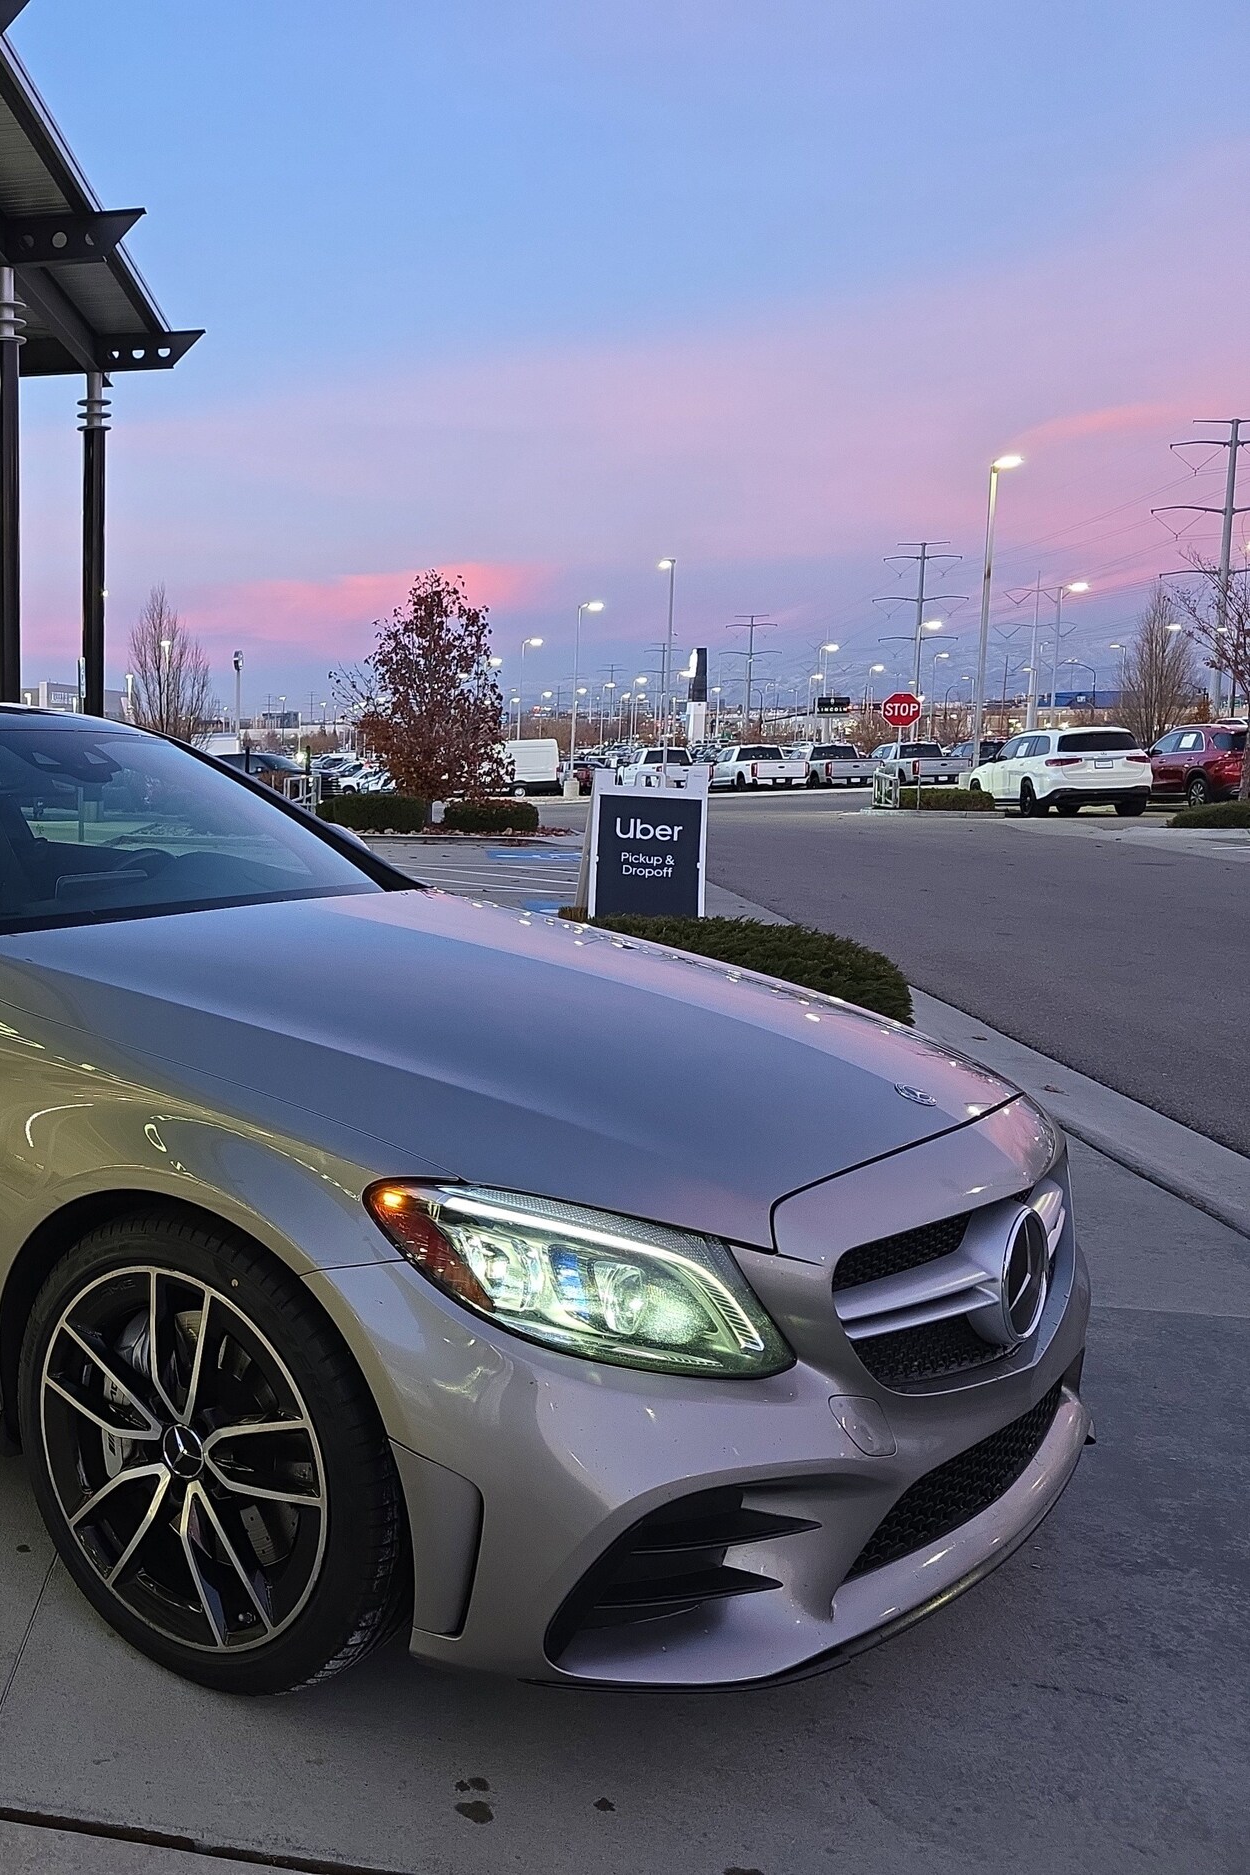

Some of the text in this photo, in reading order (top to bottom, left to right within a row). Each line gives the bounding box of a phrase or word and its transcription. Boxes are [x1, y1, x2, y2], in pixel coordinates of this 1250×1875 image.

[884, 703, 919, 717] STOP
[615, 817, 683, 842] Uber
[621, 852, 675, 867] Pickup &
[622, 864, 673, 879] Dropoff
